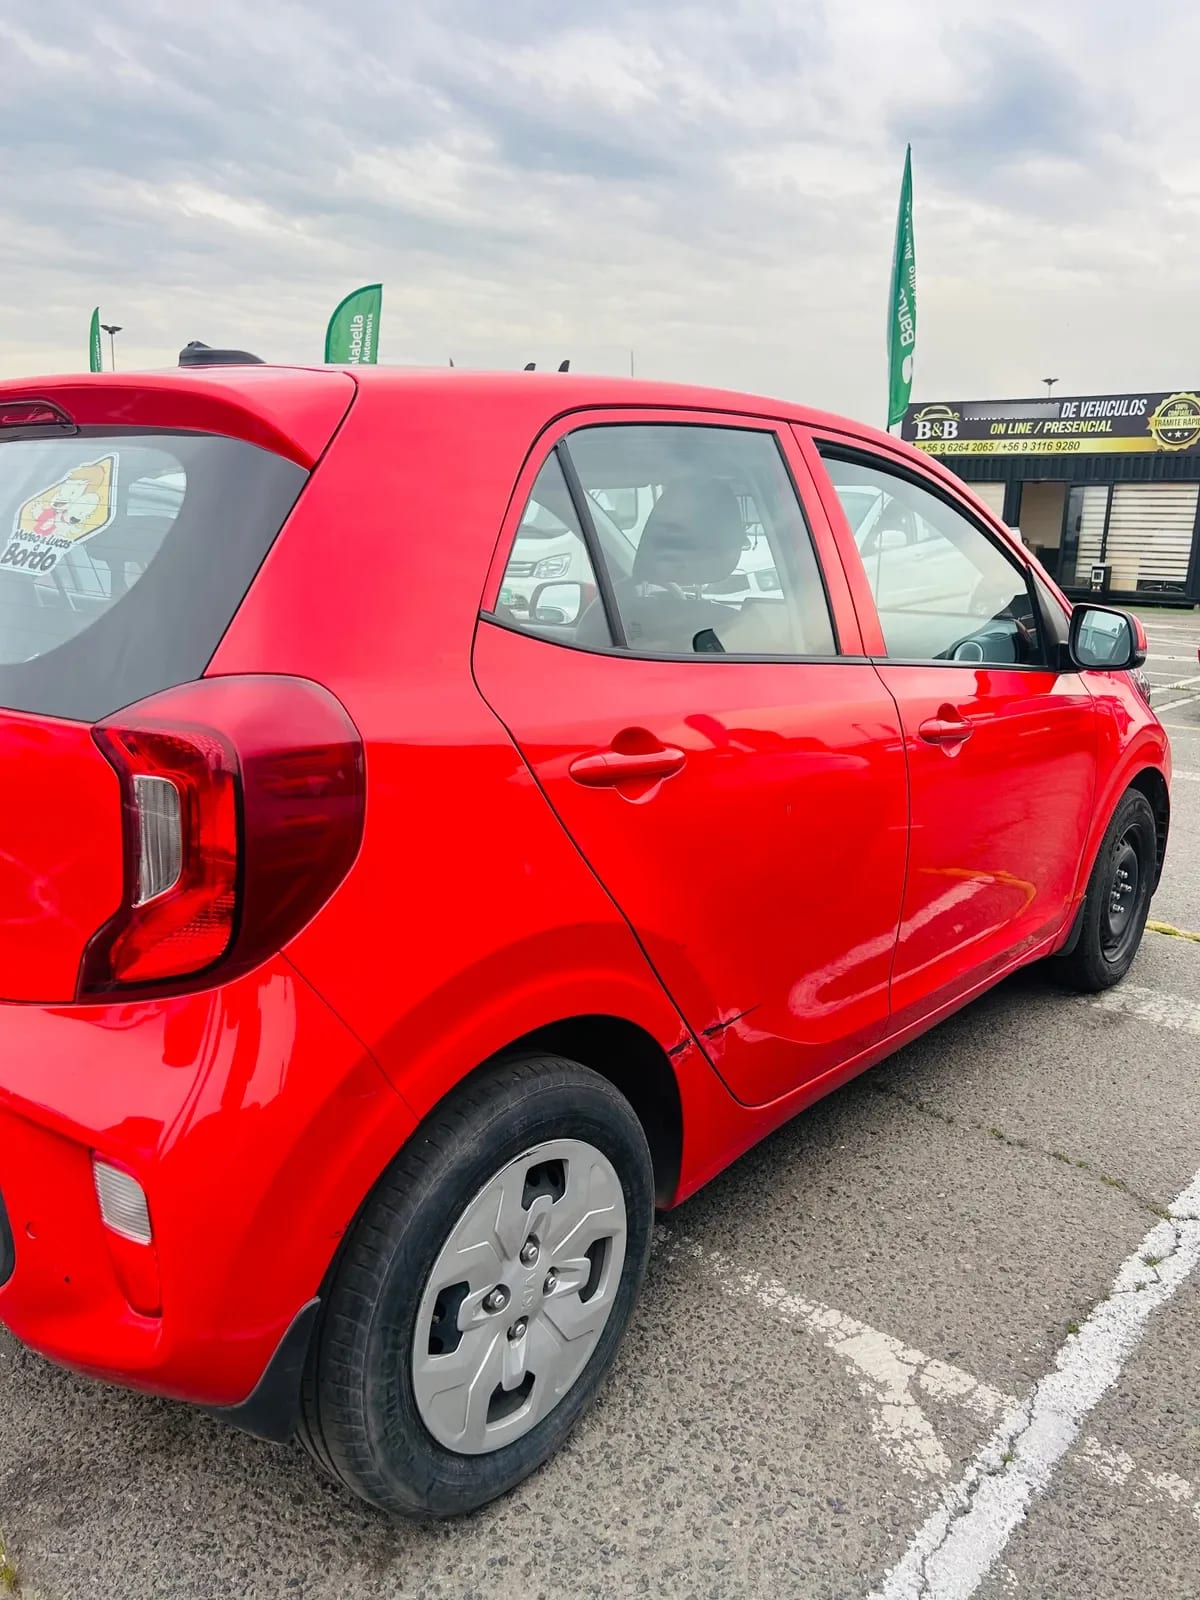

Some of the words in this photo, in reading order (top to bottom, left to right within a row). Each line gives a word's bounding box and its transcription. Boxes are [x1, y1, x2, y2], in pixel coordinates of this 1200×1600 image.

[1061, 402, 1079, 418] DE
[1080, 398, 1148, 418] VEHICULOS
[915, 420, 959, 440] B&B
[990, 423, 1006, 434] ON
[1007, 422, 1033, 434] LINE
[1033, 421, 1042, 434] /
[1043, 420, 1113, 434] PRESENCIAL
[940, 443, 946, 452] 9
[948, 442, 969, 452] 6264
[972, 442, 994, 452] 2065
[1002, 442, 1019, 452] +56
[1021, 442, 1028, 451] 9
[1030, 441, 1051, 452] 3116
[1055, 441, 1081, 452] 9280
[0, 543, 57, 571] Bordo
